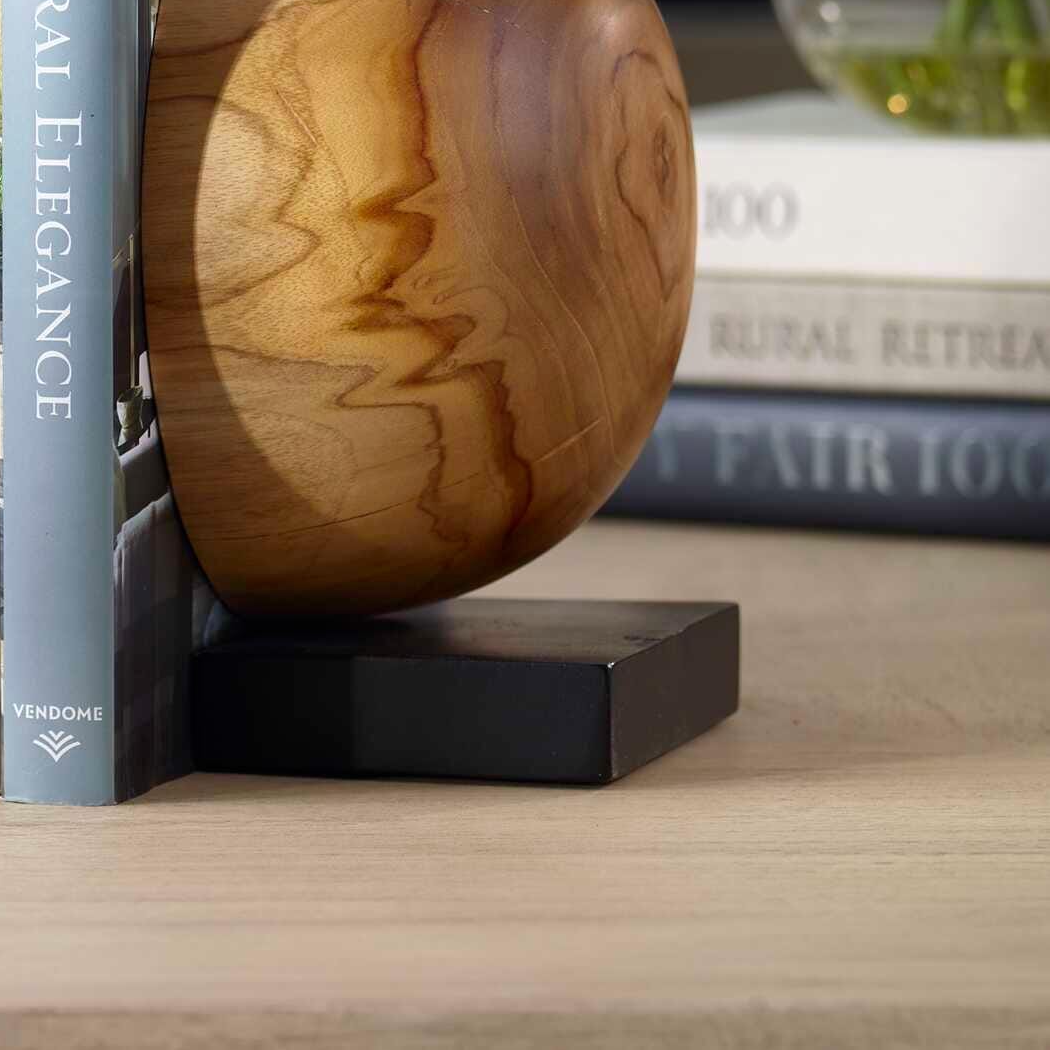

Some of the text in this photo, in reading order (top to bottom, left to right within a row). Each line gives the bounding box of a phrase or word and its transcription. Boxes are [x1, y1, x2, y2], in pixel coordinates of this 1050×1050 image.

[33, 109, 84, 422] ELEGANCE
[709, 313, 854, 366] RURAL
[713, 419, 895, 497] FAIR
[13, 703, 103, 722] VENDOME
